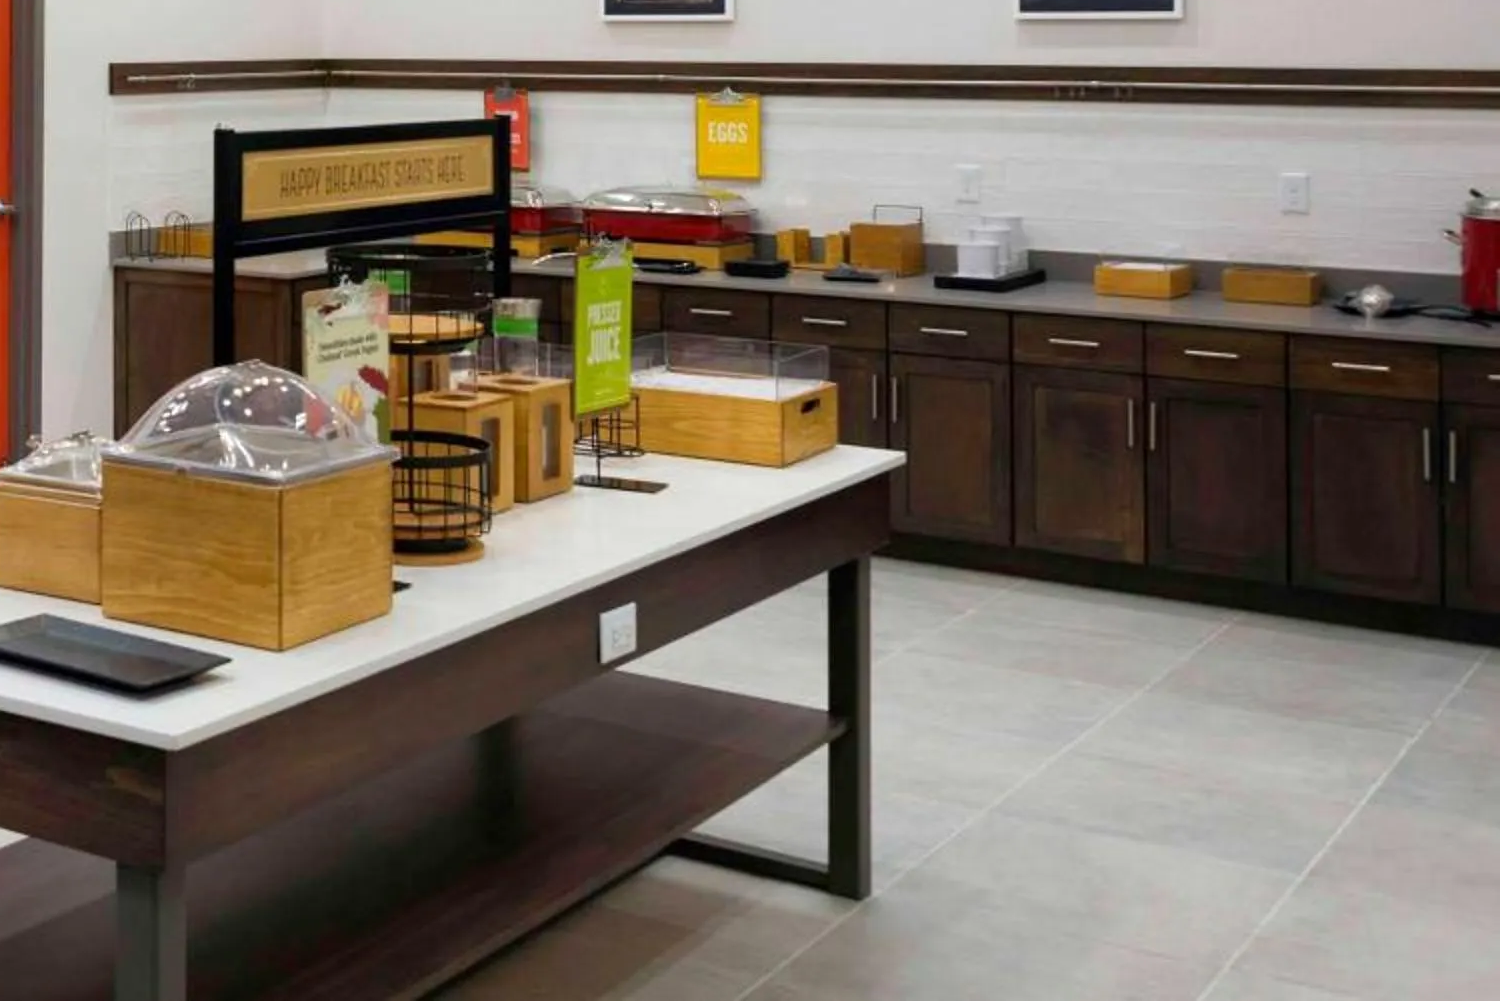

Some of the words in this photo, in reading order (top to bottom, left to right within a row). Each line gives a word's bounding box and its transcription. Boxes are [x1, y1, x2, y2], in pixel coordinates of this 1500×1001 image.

[707, 121, 749, 145] EGGS
[280, 167, 321, 198] HAPPY
[325, 160, 391, 195] BREAKFAST
[394, 156, 435, 187] STARTS
[437, 154, 466, 184] HERE
[586, 326, 621, 366] JUICE
